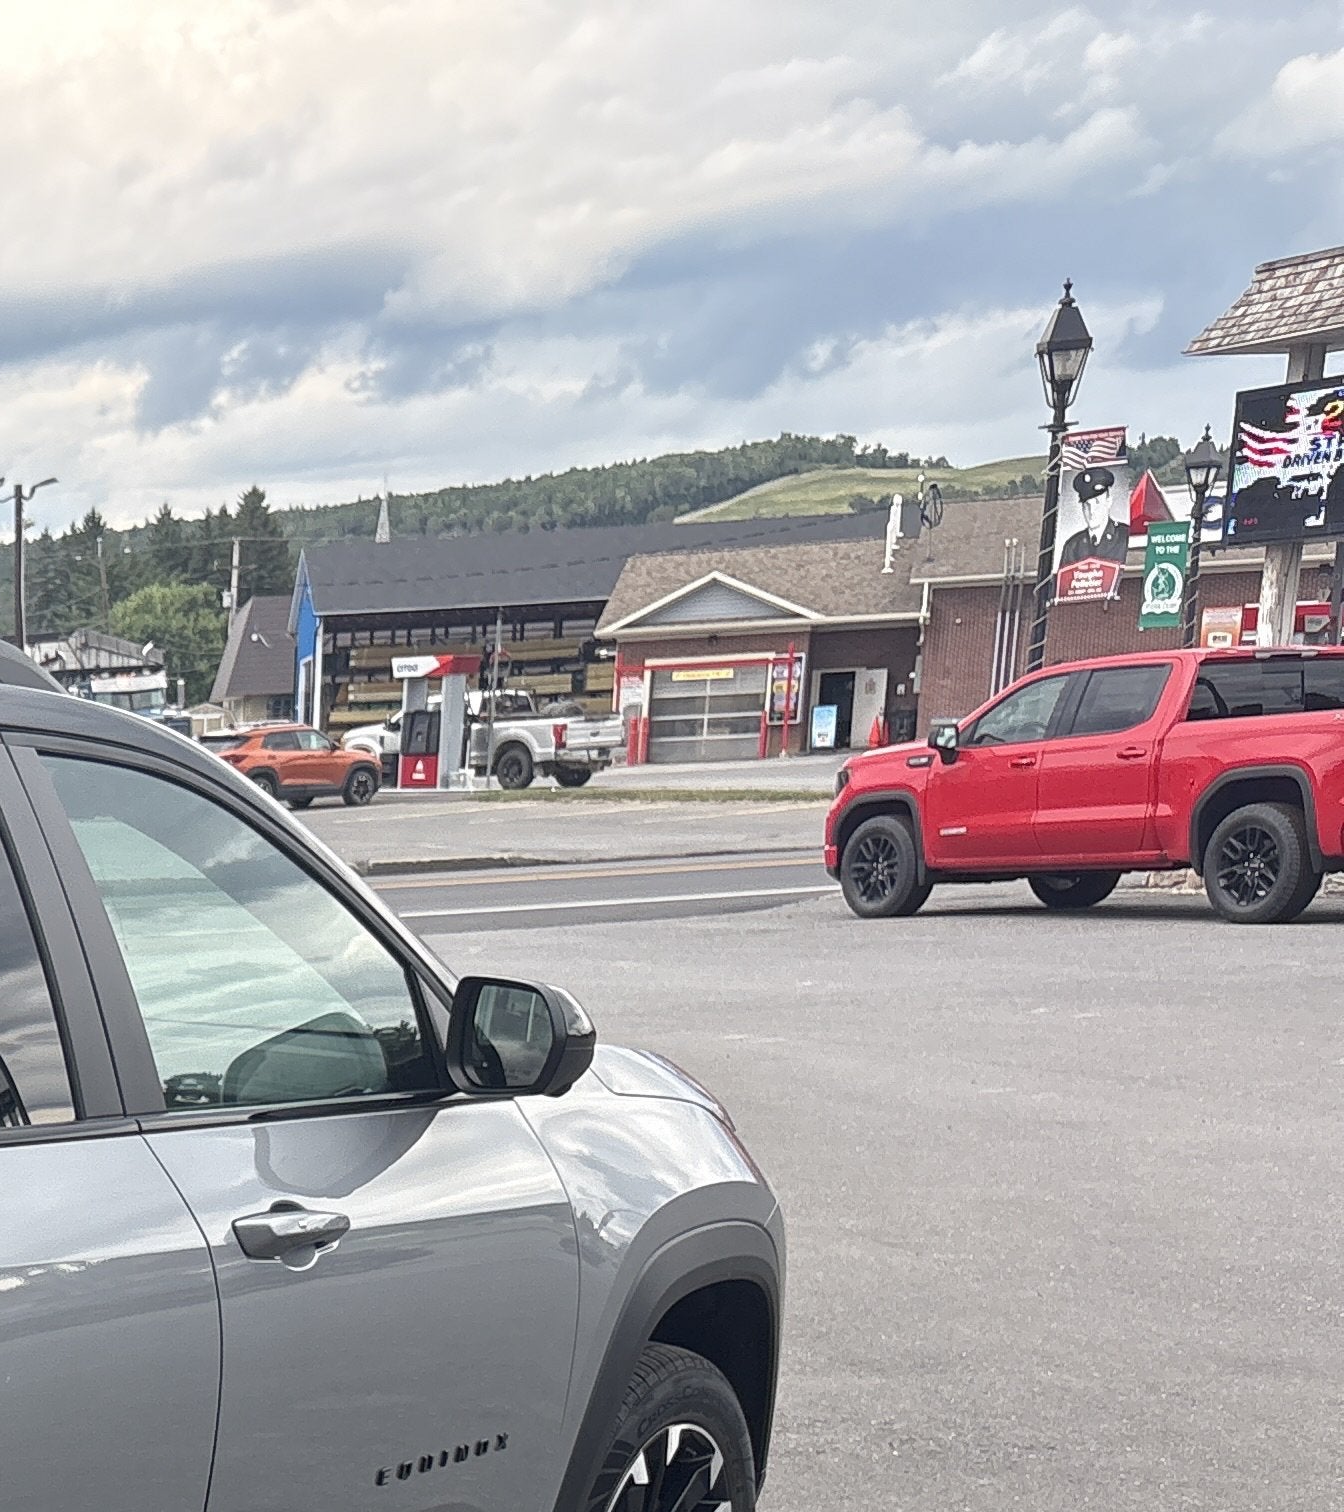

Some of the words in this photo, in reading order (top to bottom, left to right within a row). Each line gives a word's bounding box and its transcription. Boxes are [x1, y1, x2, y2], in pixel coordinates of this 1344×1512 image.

[1283, 448, 1333, 468] DRIVEN
[1150, 533, 1187, 544] WELCOME
[1155, 546, 1166, 555] TO
[1166, 545, 1180, 555] THE
[375, 1432, 509, 1487] EQUINOX
